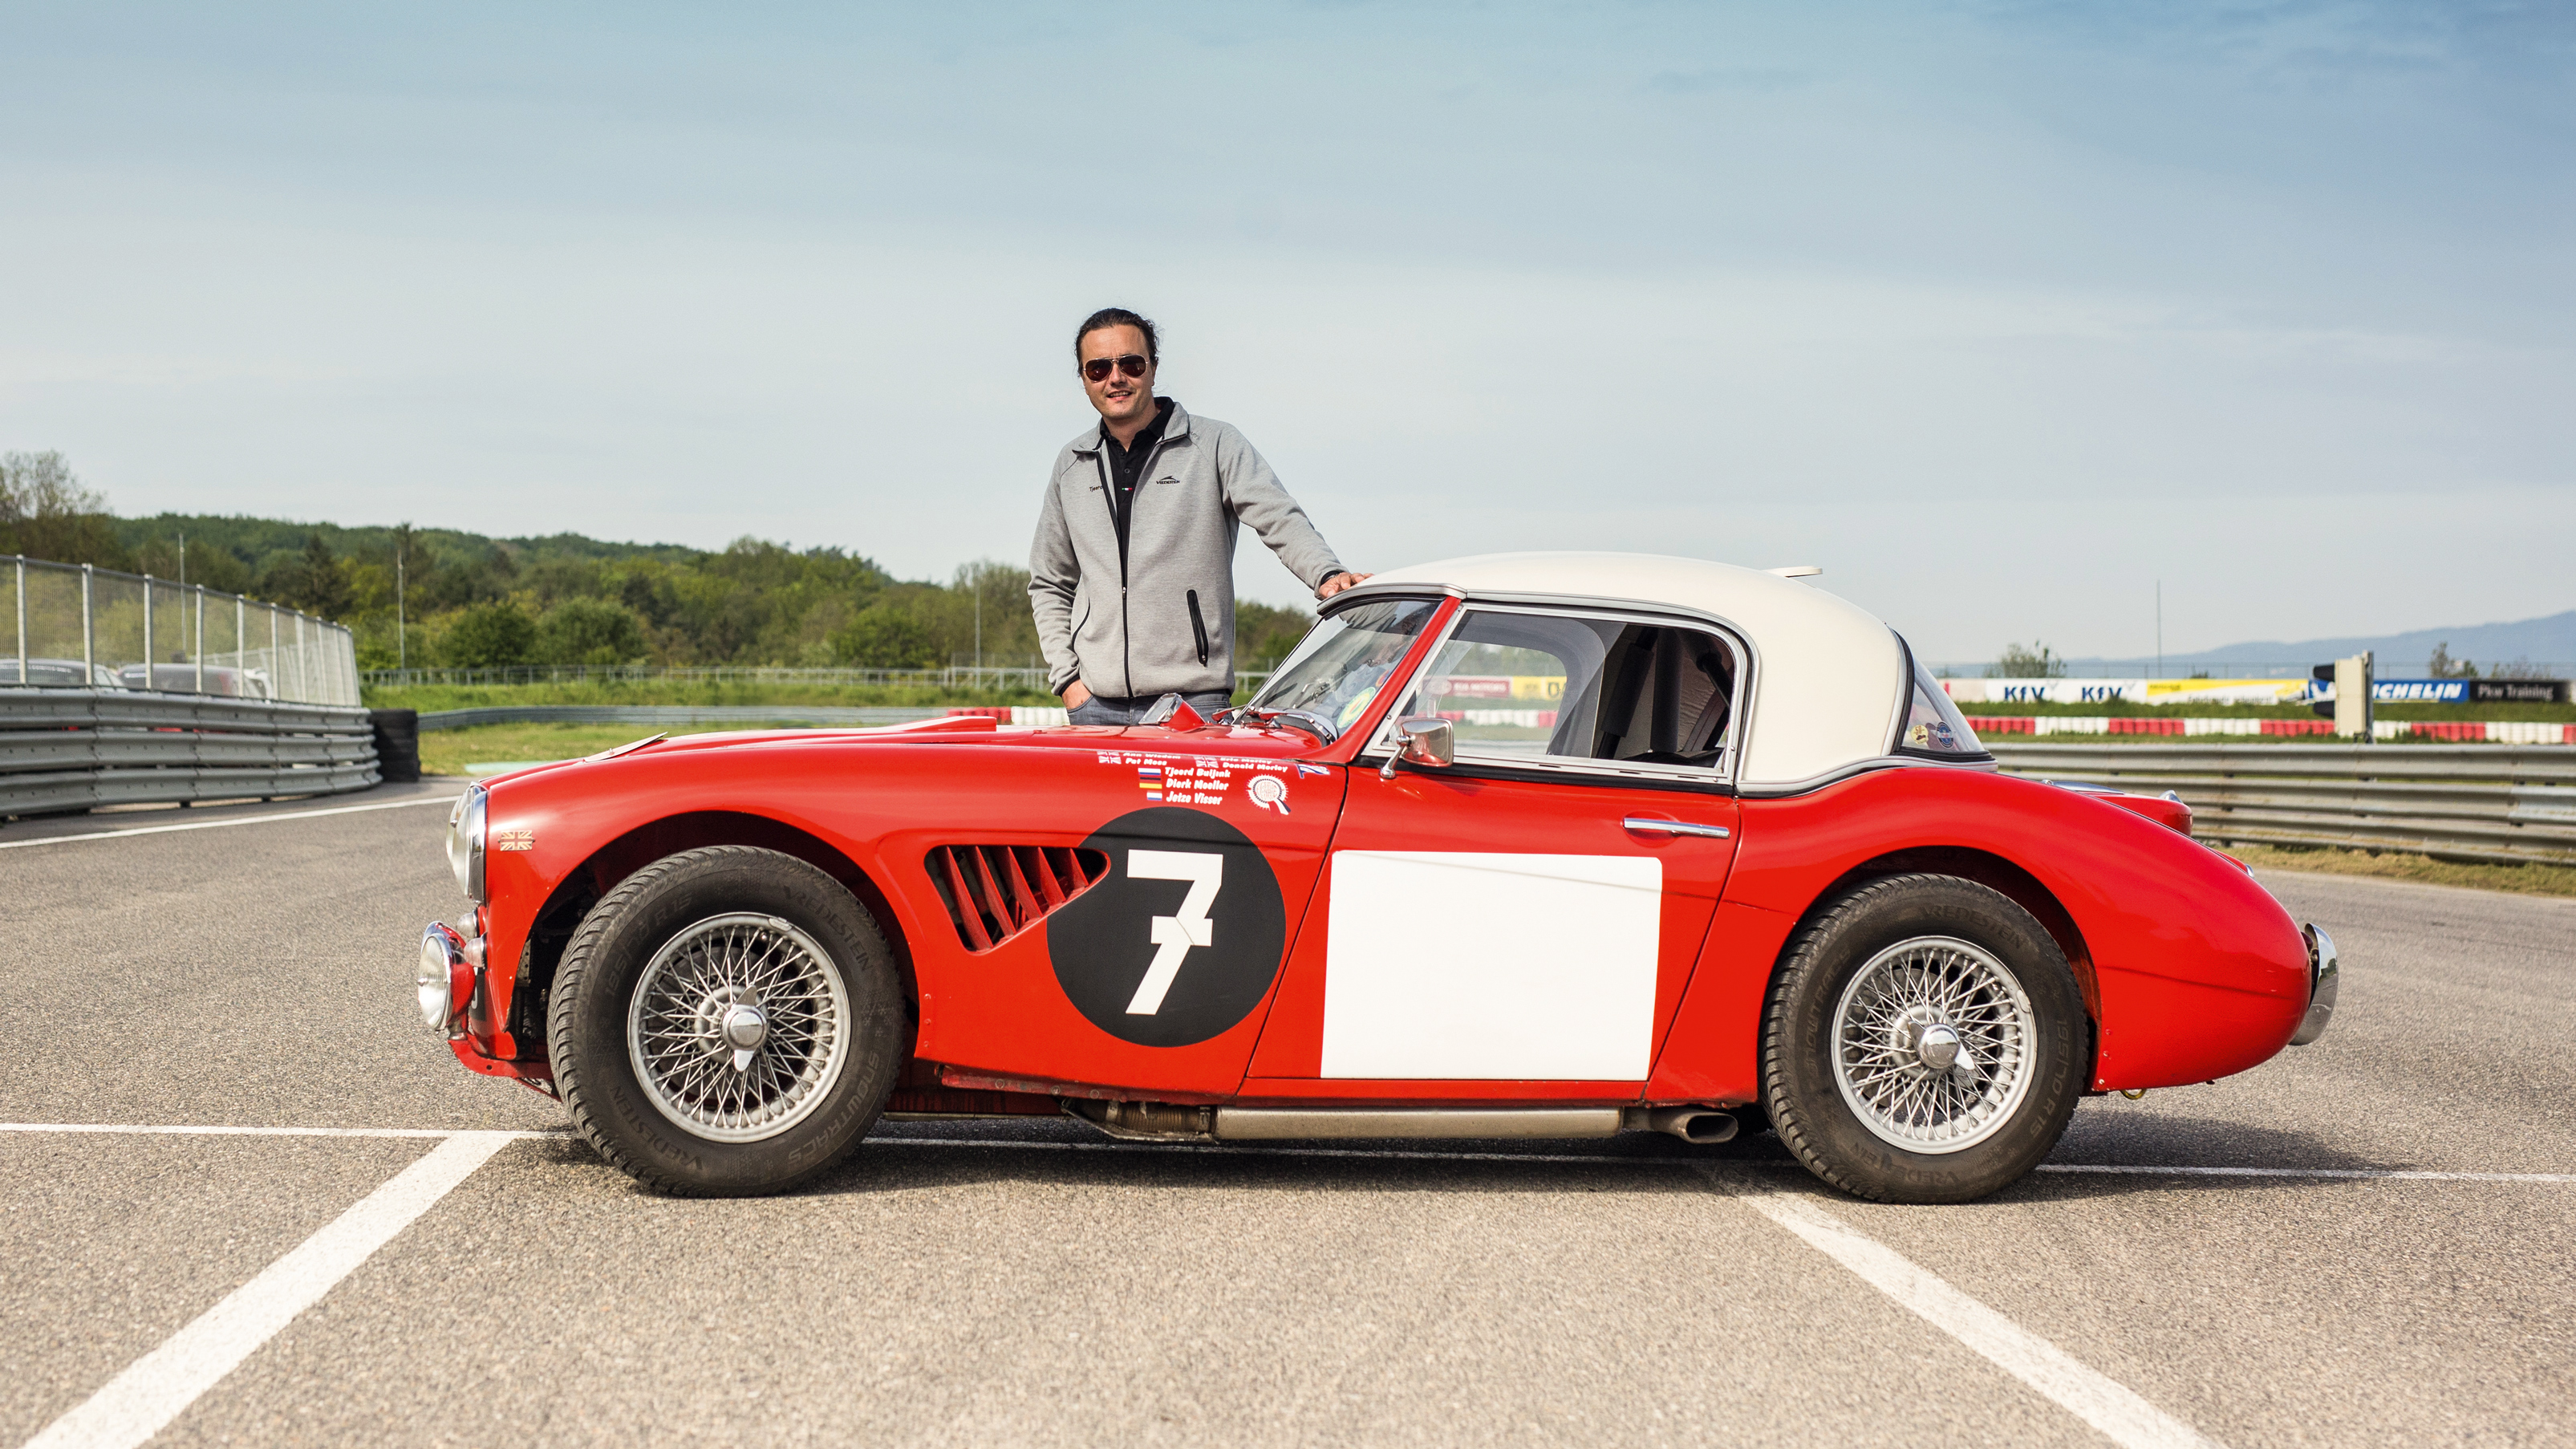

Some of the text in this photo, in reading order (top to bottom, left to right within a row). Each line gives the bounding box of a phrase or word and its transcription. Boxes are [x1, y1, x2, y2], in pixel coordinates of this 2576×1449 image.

[2372, 683, 2462, 699] ICHELIN
[2477, 683, 2554, 700] Pkw Training
[1165, 767, 1195, 777] Tjeerd
[1256, 764, 1288, 773] Morley
[1166, 778, 1229, 790] Dierk Moeller
[1166, 791, 1223, 805] Jetze Visser
[781, 884, 872, 972] VREDESTEIN
[1126, 850, 1223, 1015] 7
[1921, 904, 2022, 951] VREDESTEIN
[610, 1085, 704, 1171] VREDESTEIN
